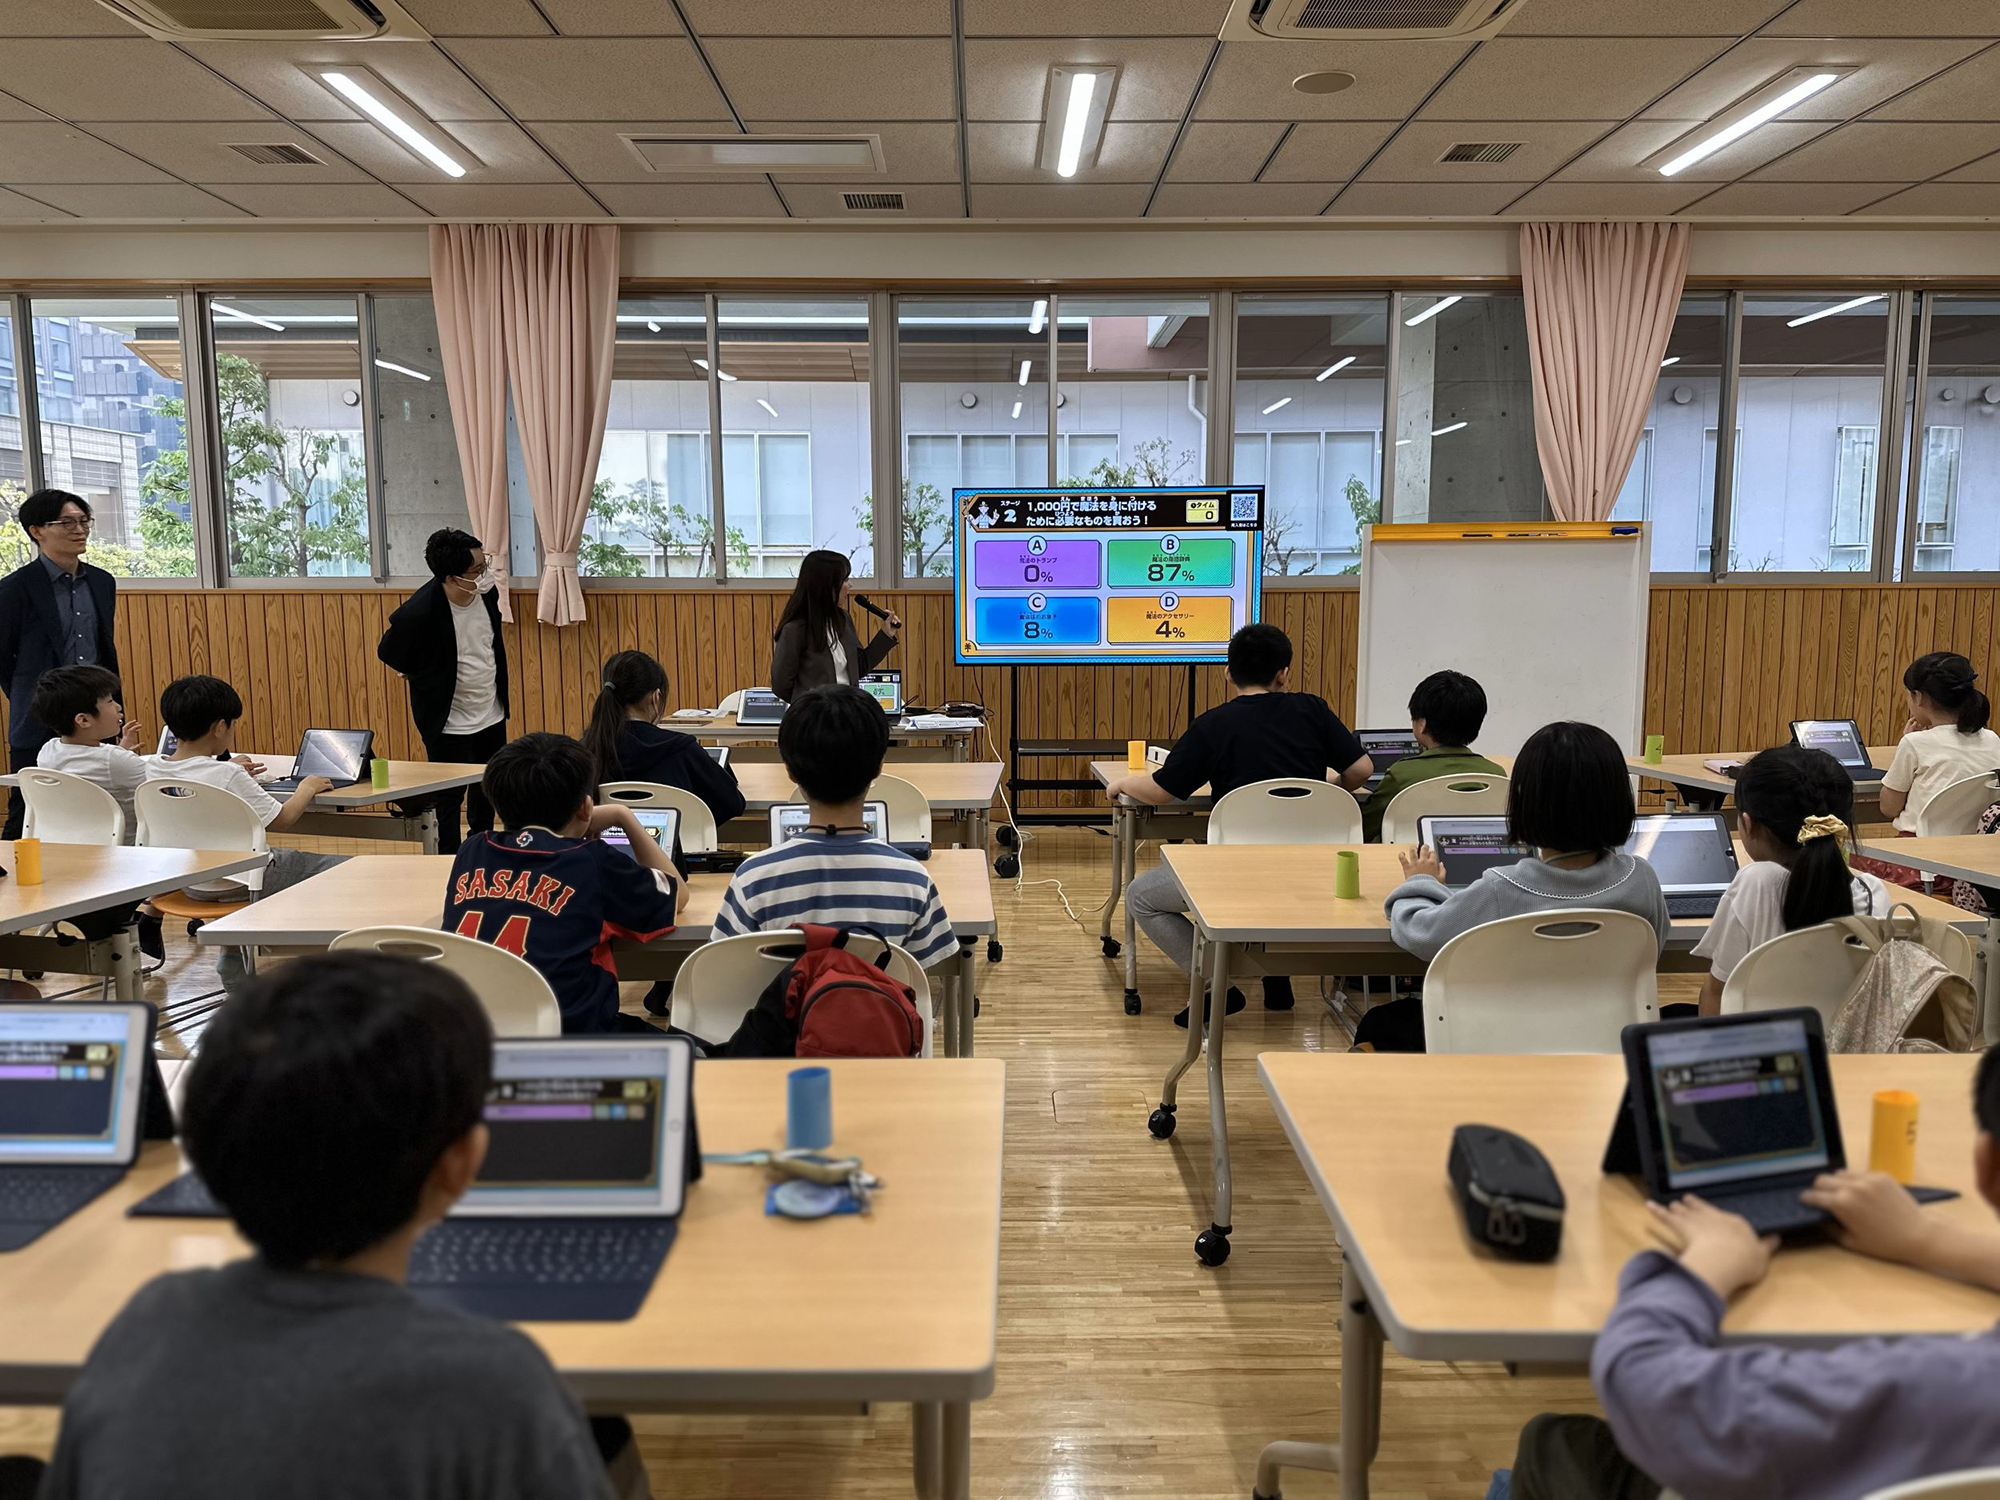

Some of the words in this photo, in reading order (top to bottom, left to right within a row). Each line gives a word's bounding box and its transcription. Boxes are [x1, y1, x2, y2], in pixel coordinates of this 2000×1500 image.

[1027, 500, 1157, 512] 1,000円で魔法を身に付ける
[1003, 509, 1017, 523] 2
[1205, 511, 1214, 520] 0
[1032, 540, 1043, 551] A
[1166, 539, 1175, 550] B
[1024, 564, 1054, 583] 0%
[1147, 563, 1195, 582] 87%
[1032, 597, 1042, 608] C
[1165, 596, 1175, 607] D
[1024, 621, 1054, 639] 8%
[1155, 620, 1186, 638] 4%
[454, 868, 576, 916] SASAKI
